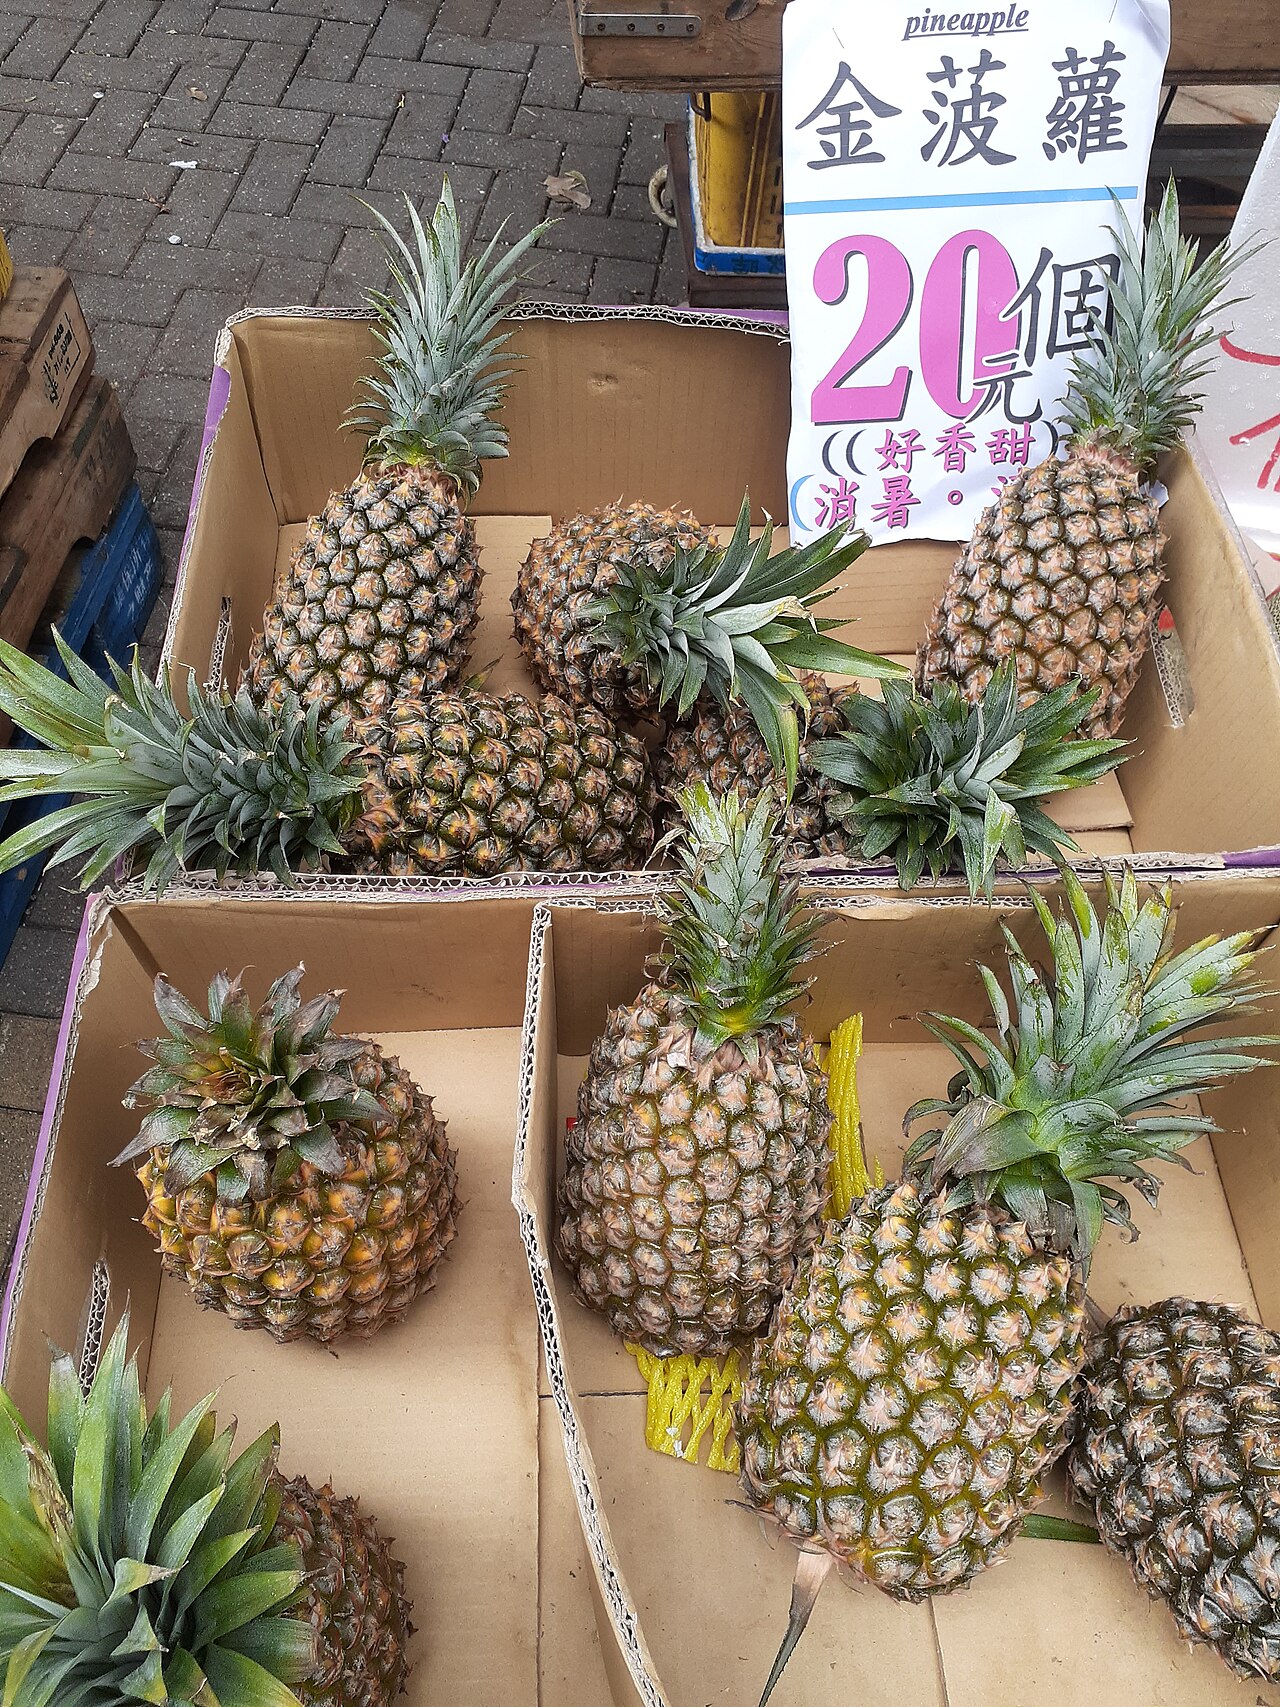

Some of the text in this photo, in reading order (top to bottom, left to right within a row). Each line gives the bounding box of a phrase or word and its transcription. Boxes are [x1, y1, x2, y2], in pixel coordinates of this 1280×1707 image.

[901, 3, 1029, 41] pineapple
[795, 40, 1128, 170] 金菠蘿
[811, 229, 1021, 426] 20
[1000, 247, 1121, 367] 個
